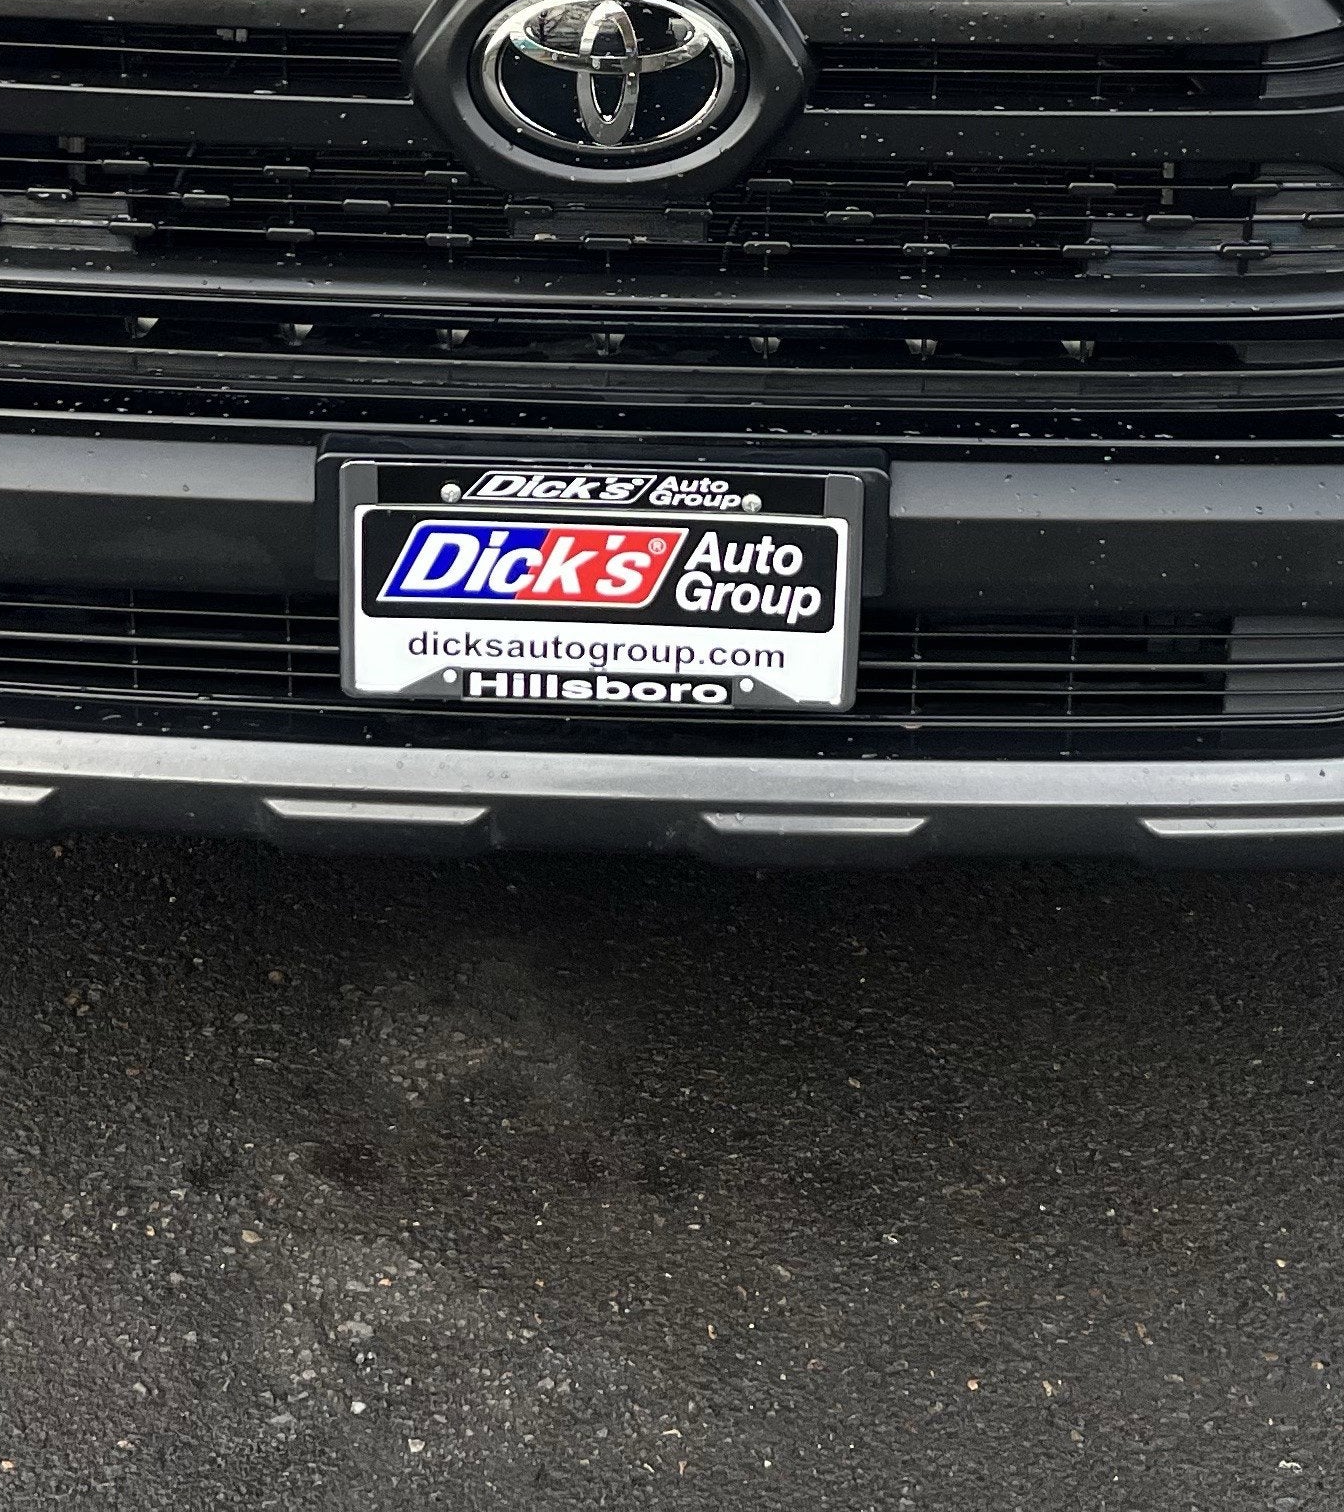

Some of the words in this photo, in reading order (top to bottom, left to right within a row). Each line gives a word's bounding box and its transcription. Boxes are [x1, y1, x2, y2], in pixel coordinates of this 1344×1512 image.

[477, 474, 635, 500] Dick's
[648, 489, 742, 510] Group
[655, 475, 729, 493] Auto
[400, 530, 652, 597] Dick's
[683, 531, 804, 576] Auto
[675, 570, 822, 625] Group
[408, 630, 785, 673] dicksautogroup.com
[469, 670, 728, 704] Hillsboro
